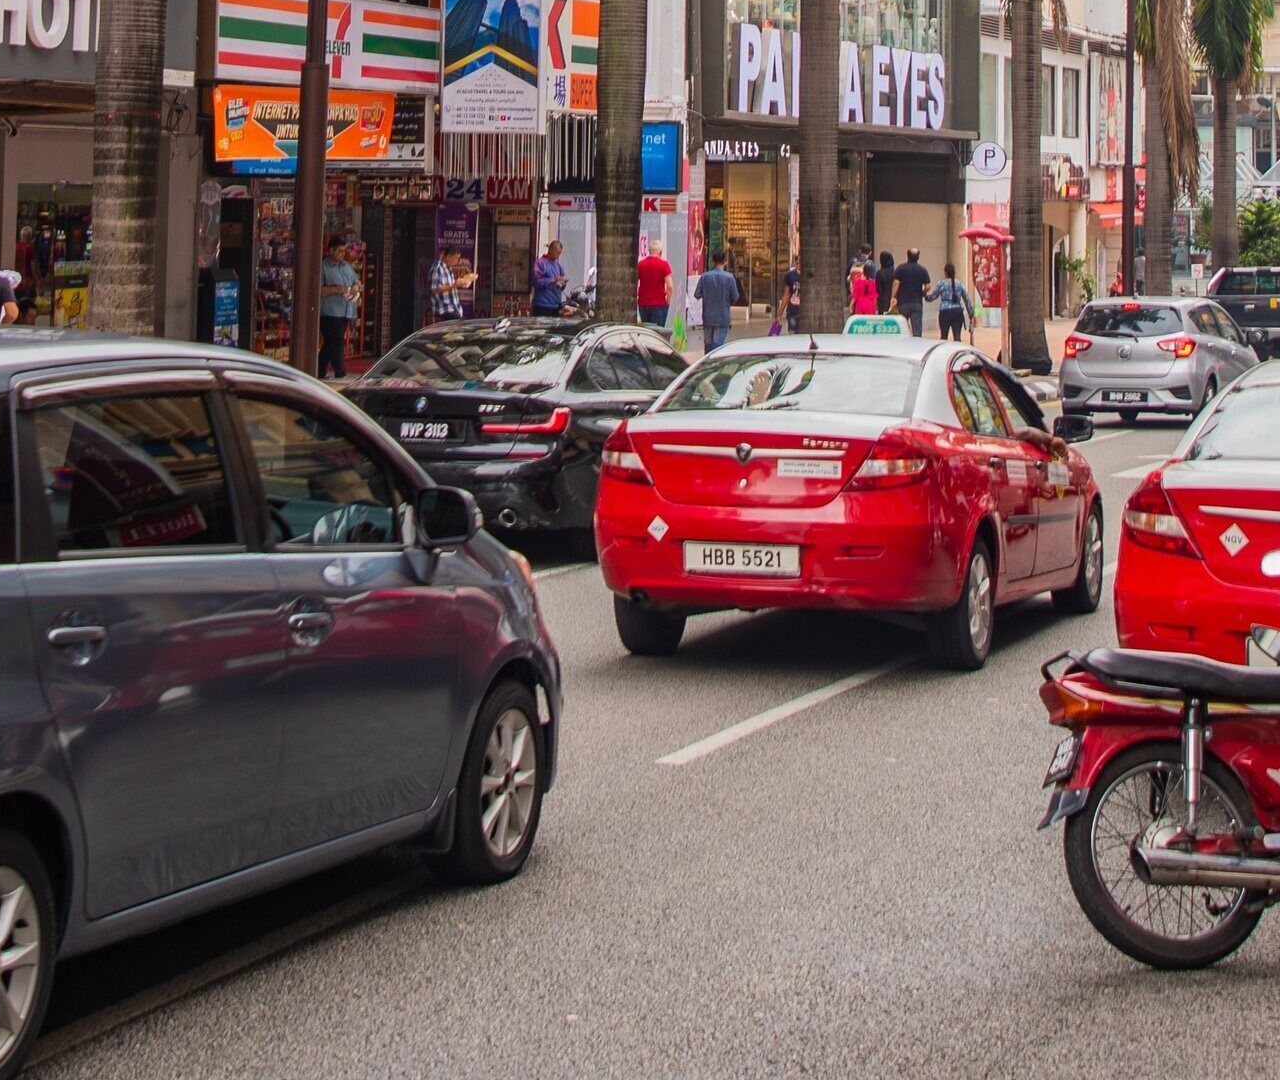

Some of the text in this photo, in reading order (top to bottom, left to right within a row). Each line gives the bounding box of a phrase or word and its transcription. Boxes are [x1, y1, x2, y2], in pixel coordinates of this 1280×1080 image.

[871, 44, 946, 131] EYES
[253, 101, 292, 120] INTERNET
[446, 178, 530, 201] 24 JAM
[442, 230, 470, 239] GRATIS
[424, 423, 449, 439] 3113
[1223, 534, 1244, 545] NGV
[702, 547, 782, 568] HBB 5521
